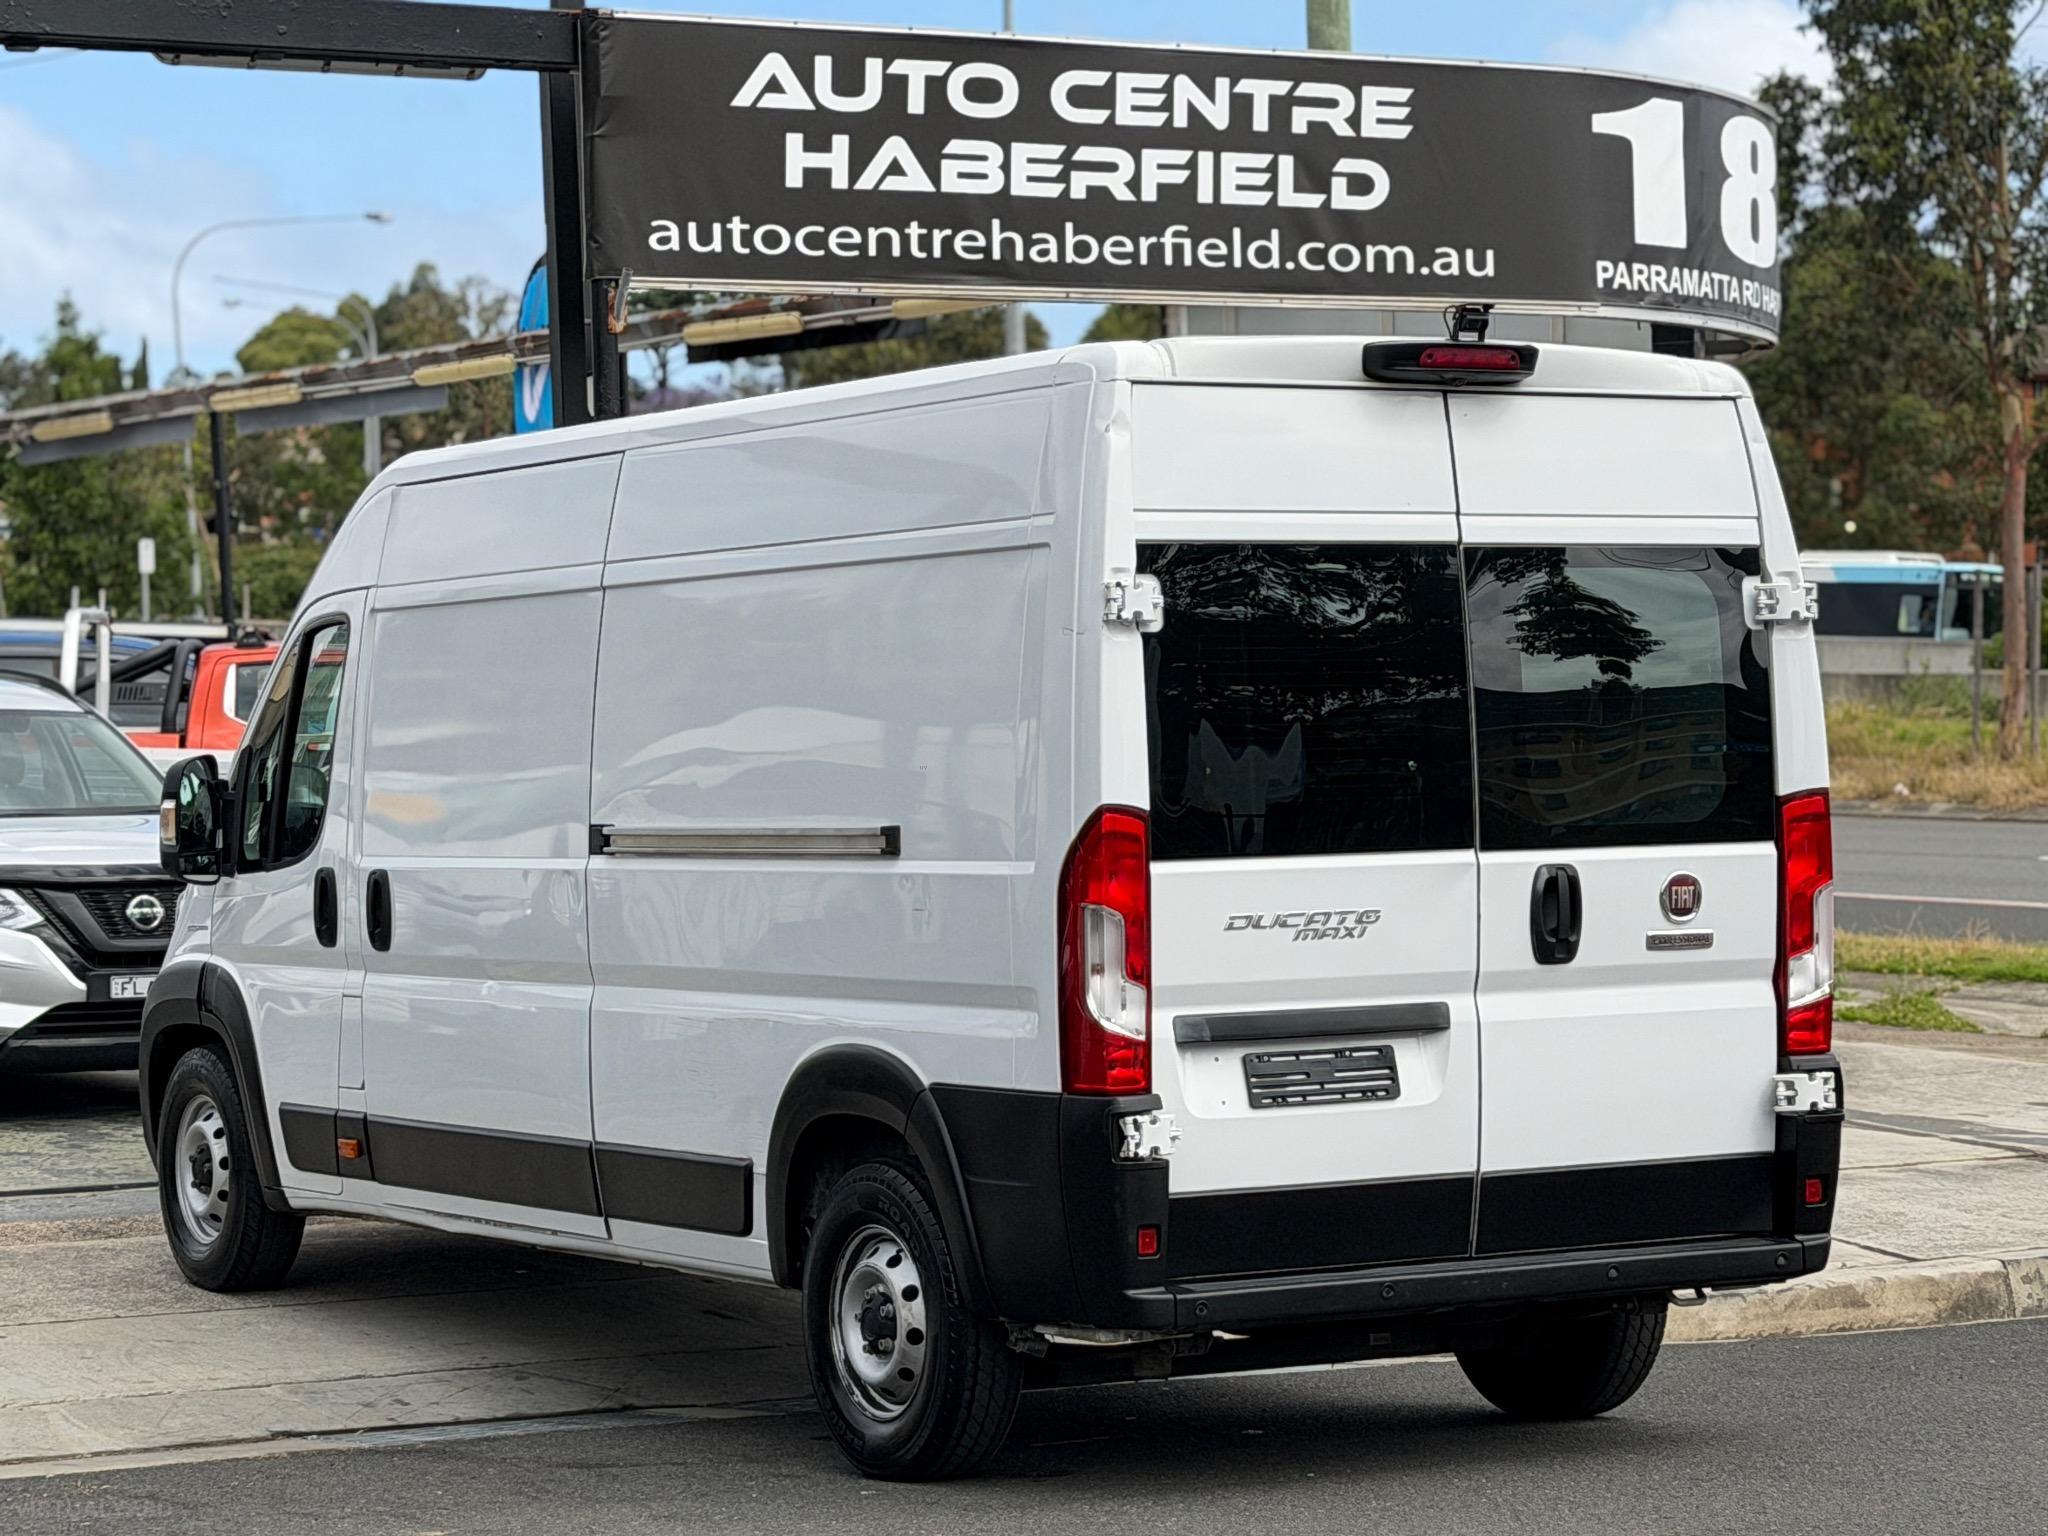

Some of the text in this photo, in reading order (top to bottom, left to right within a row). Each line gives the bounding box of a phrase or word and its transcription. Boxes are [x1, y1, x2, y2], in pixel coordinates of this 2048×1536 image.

[730, 51, 1414, 139] AUTO CENTRE
[785, 133, 1390, 211] HABERFIELD
[1591, 97, 1777, 269] 18
[648, 215, 1496, 277] autocentrehaberfield.com.au
[1596, 260, 1740, 303] PARRAMATTA
[1742, 278, 1760, 308] RD
[1223, 907, 1382, 931] DUCATO
[1671, 886, 1695, 909] FIAT
[1292, 926, 1368, 942] MAXI
[121, 981, 153, 996] FL
